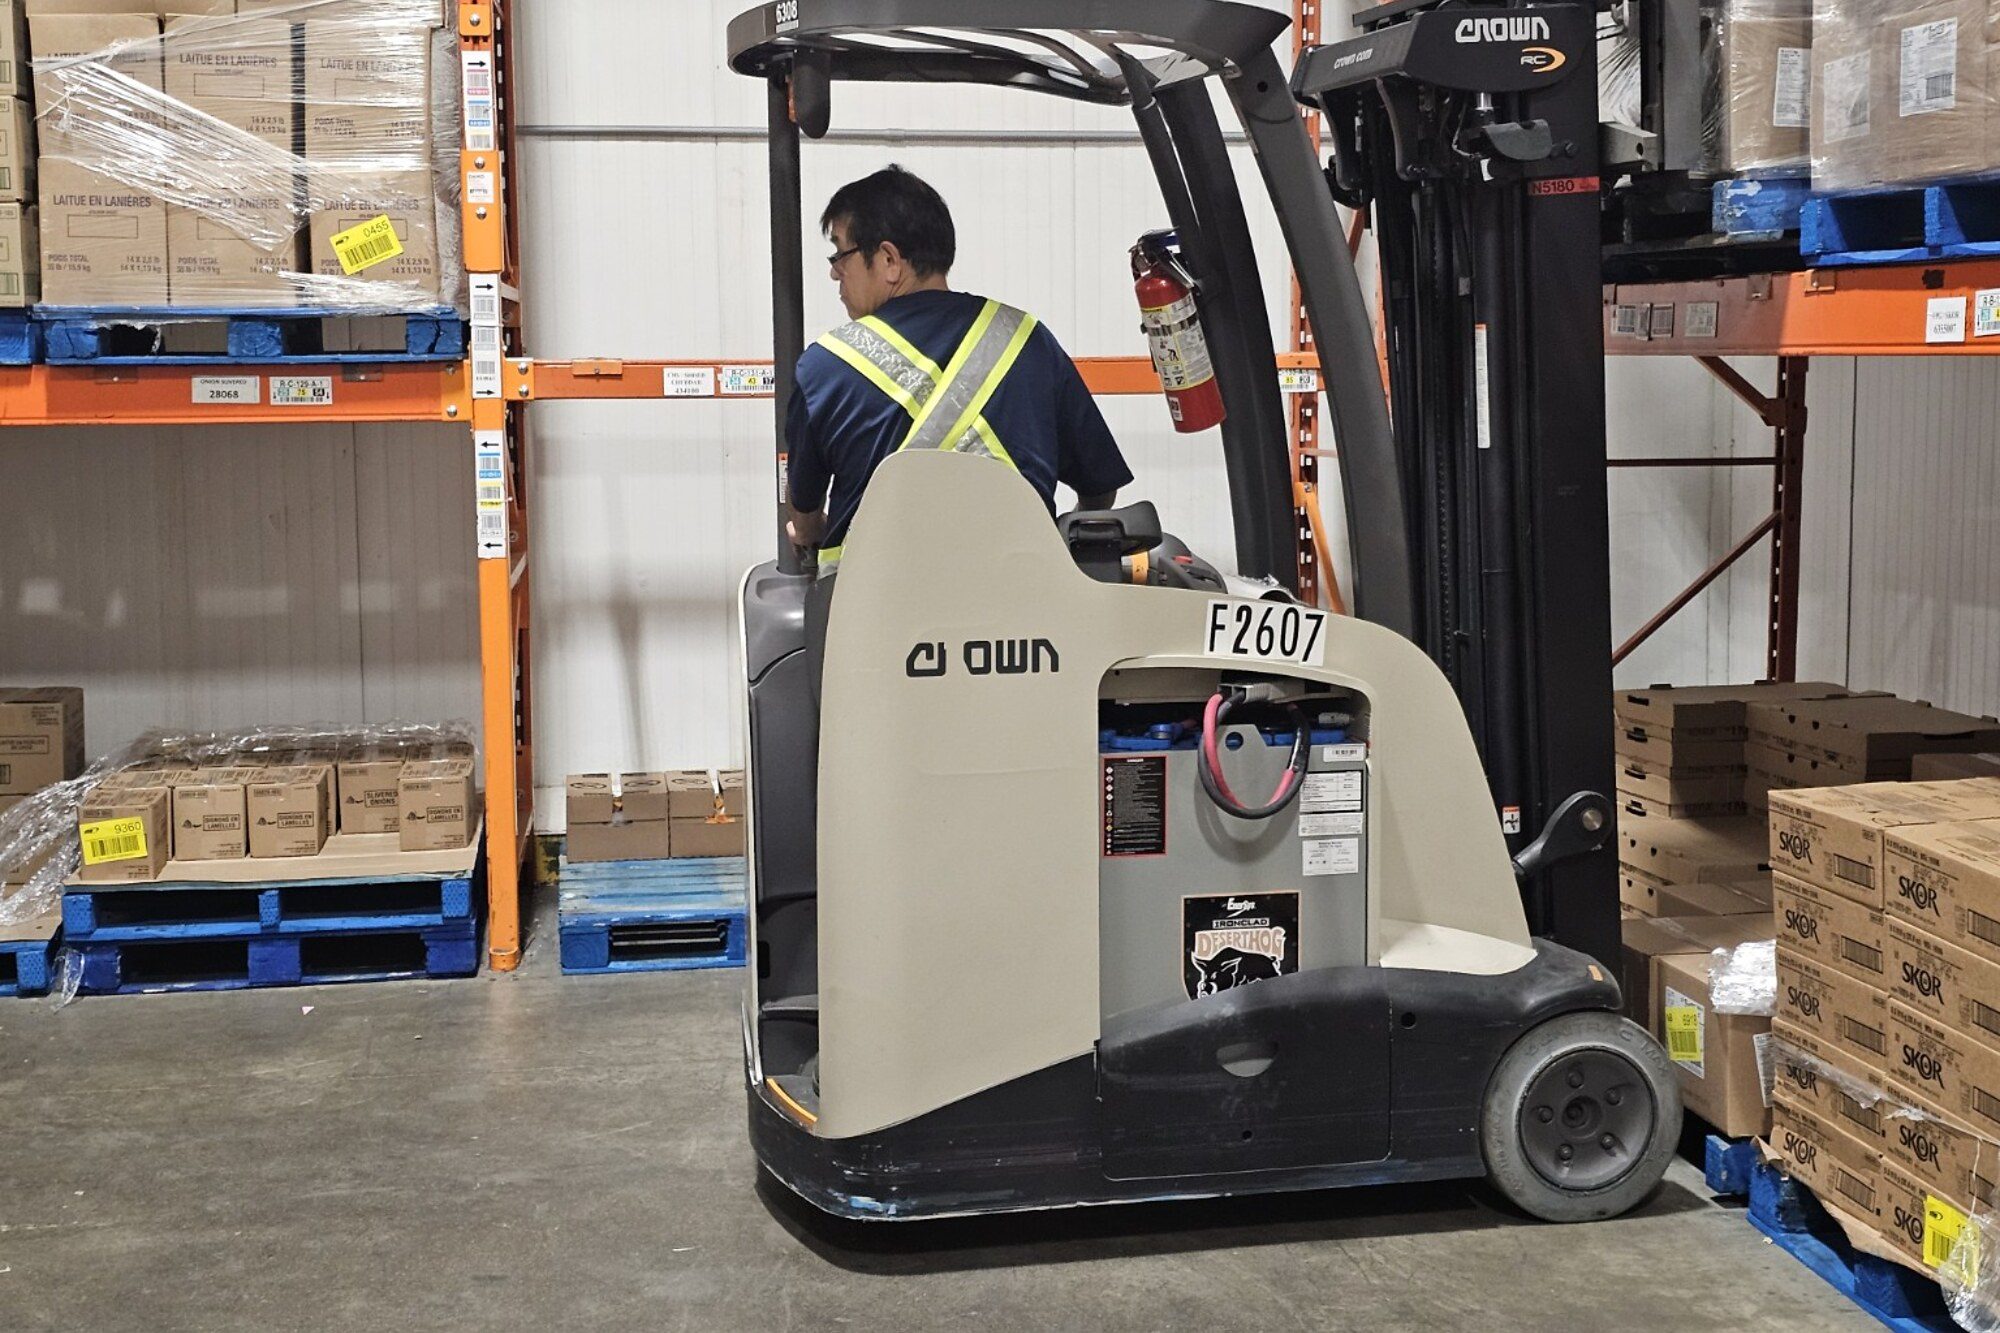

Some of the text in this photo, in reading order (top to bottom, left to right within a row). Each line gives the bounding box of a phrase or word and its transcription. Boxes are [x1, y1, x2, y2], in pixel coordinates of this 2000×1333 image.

[775, 0, 798, 23] 6308
[1455, 16, 1550, 43] CROWN
[1520, 54, 1547, 65] RC
[53, 194, 87, 207] LAITUE
[89, 195, 102, 207] EN
[1532, 179, 1575, 194] N5180
[363, 220, 389, 238] 0455
[209, 389, 240, 399] 28068
[1208, 603, 1325, 663] F2607
[114, 821, 142, 834] 9360
[1779, 831, 1813, 865] SKOR
[1898, 875, 1942, 918] SKOR
[1214, 918, 1268, 928] IRONCLAD
[1785, 908, 1821, 945] SKOR
[1197, 929, 1283, 959] DESERTHOG
[1901, 960, 1945, 1006] SKOR
[1787, 986, 1823, 1023] SKOR
[1902, 1044, 1945, 1090] SKOR
[1783, 1131, 1817, 1173] SKOR
[1899, 1124, 1941, 1172] SKOR
[1894, 1206, 1924, 1245] SKO
